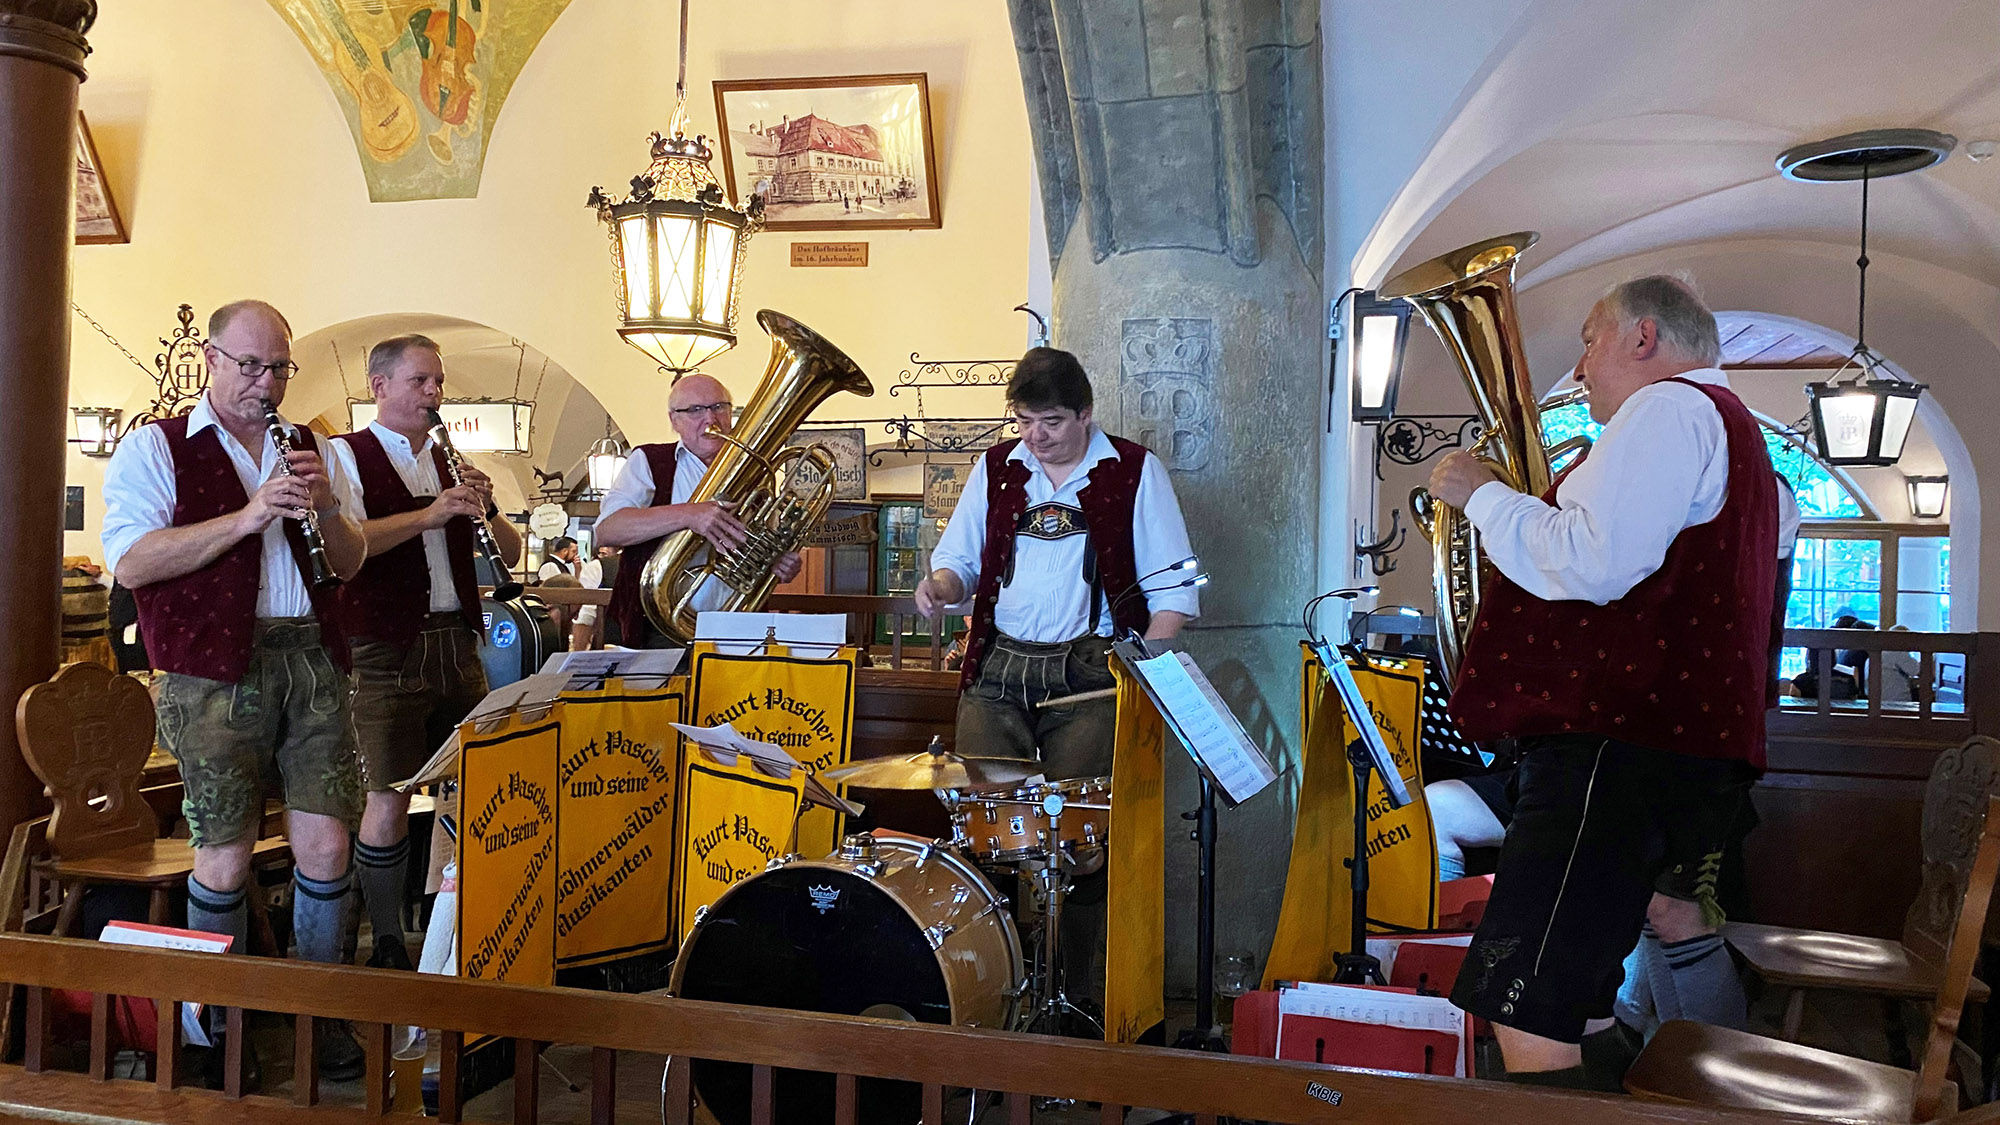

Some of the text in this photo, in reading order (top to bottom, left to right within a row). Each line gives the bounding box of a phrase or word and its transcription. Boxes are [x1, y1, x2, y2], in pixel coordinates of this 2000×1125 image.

[763, 688, 835, 743] Pascher
[603, 730, 669, 784] Pascher
[469, 771, 553, 842] Kurt Pascher
[571, 771, 649, 798] und seine
[485, 816, 540, 855] und seine
[558, 792, 669, 904] öhmerwälder
[693, 815, 730, 865] Kurt
[706, 858, 734, 885] und
[812, 891, 837, 899] REMO
[1307, 1082, 1342, 1106] KBE
